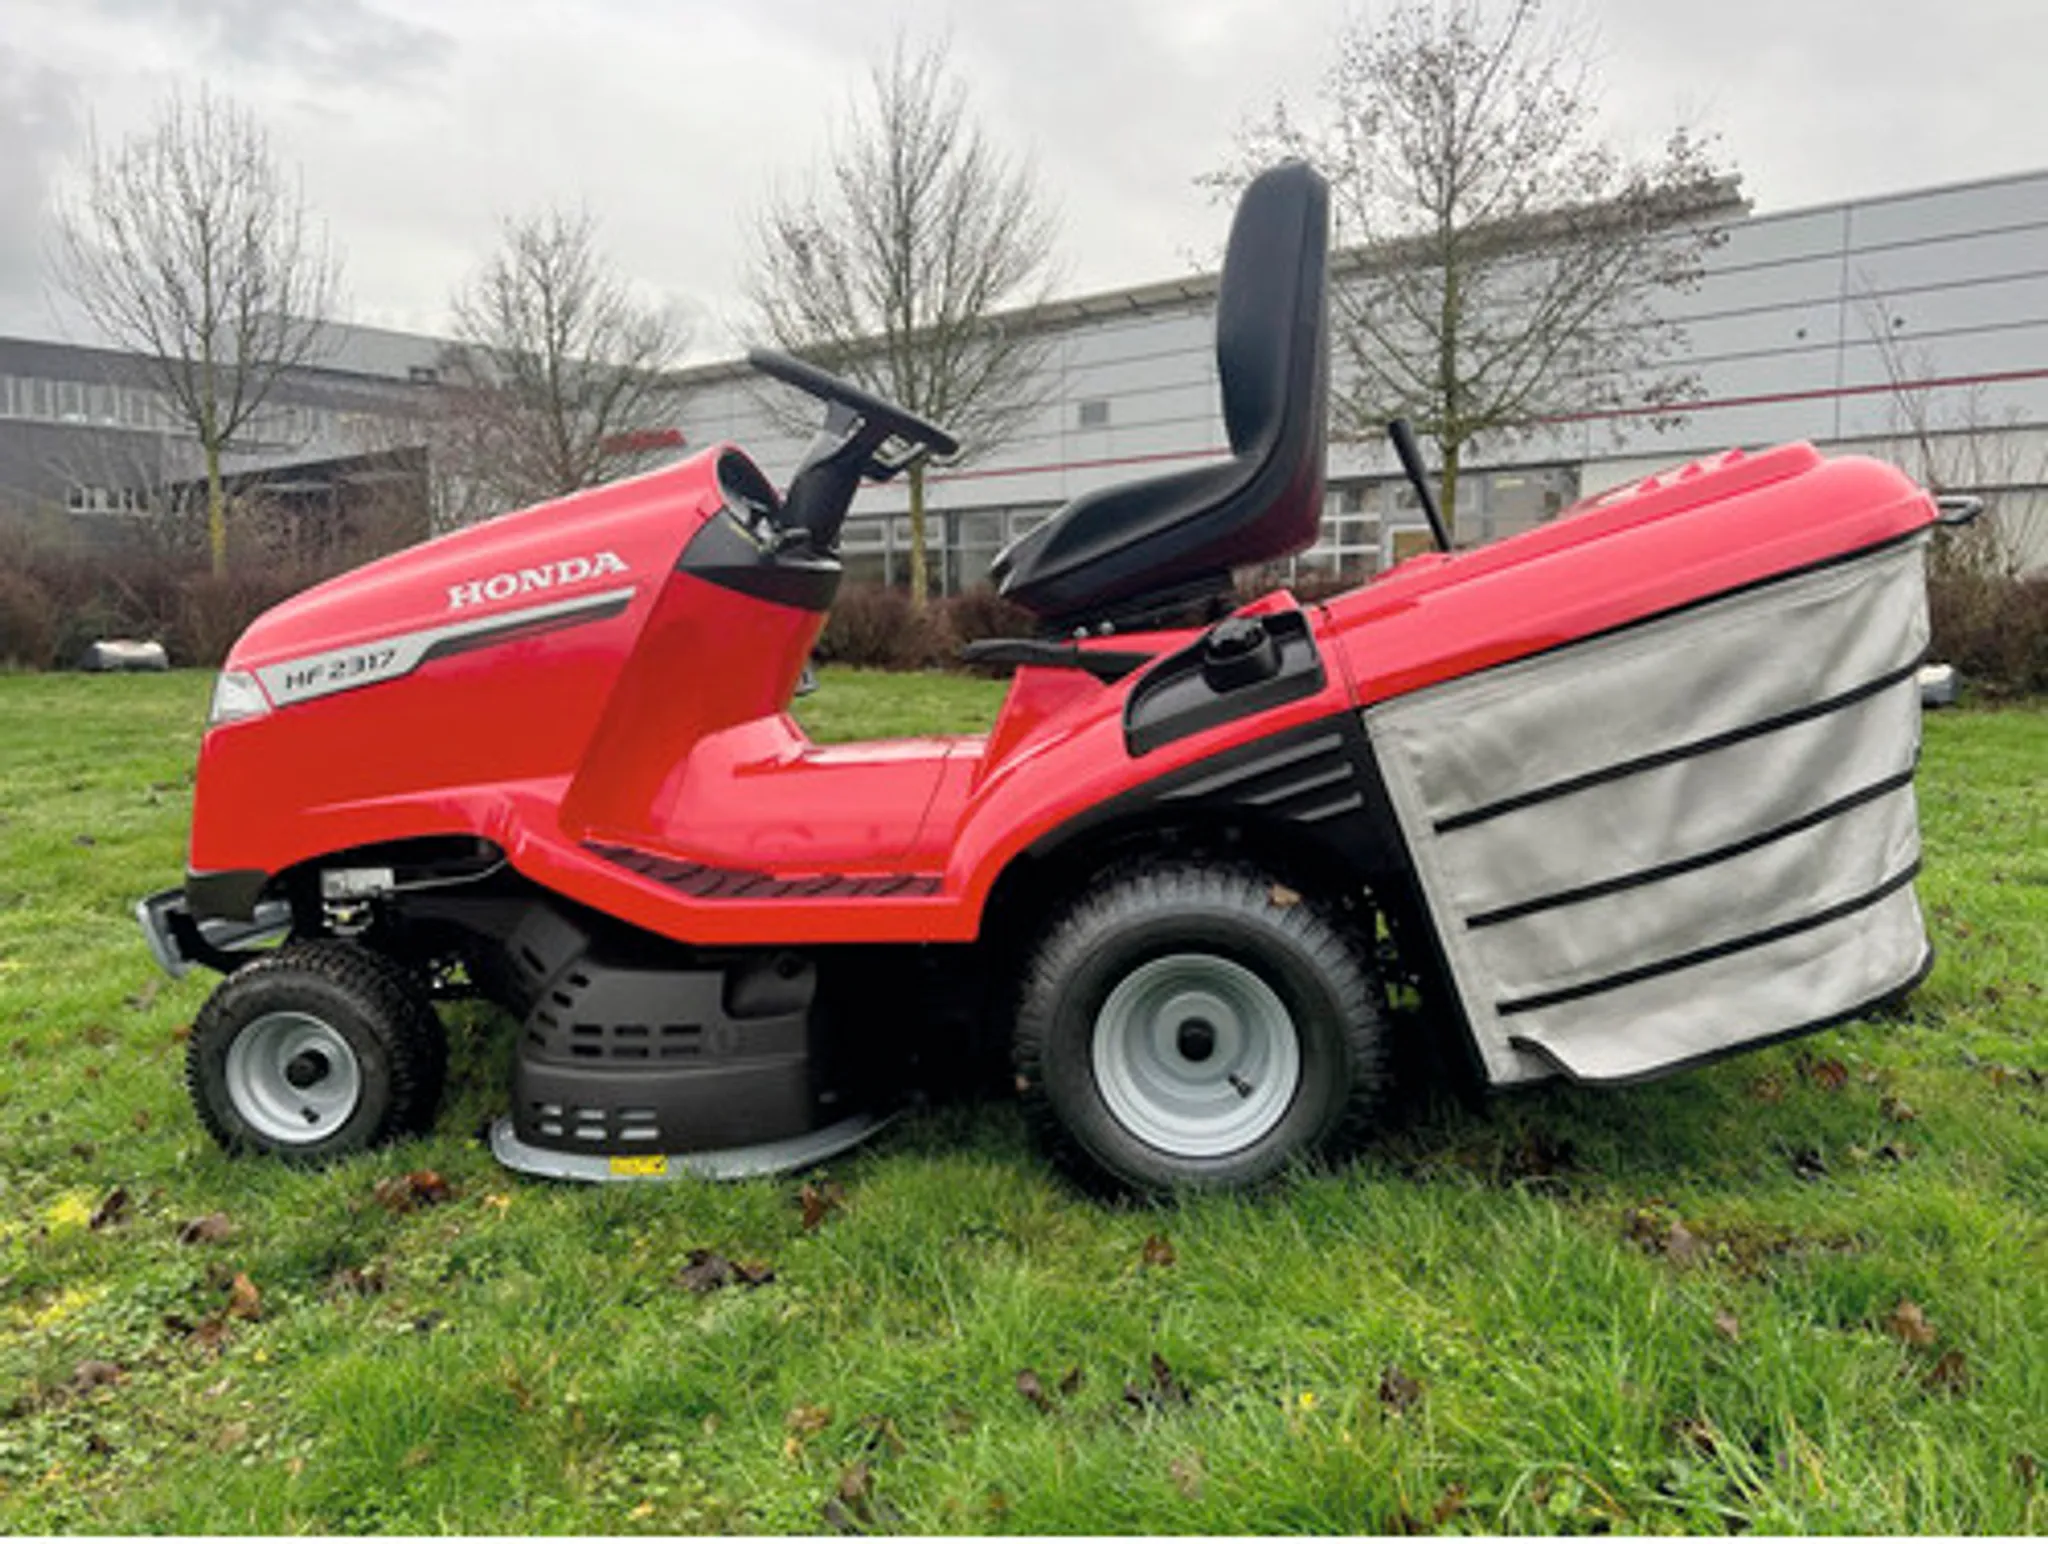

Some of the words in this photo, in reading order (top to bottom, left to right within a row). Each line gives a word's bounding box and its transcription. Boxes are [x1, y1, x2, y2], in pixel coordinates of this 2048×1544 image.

[447, 551, 628, 608] HONDA
[285, 667, 324, 690] HF
[328, 650, 396, 679] 2317
